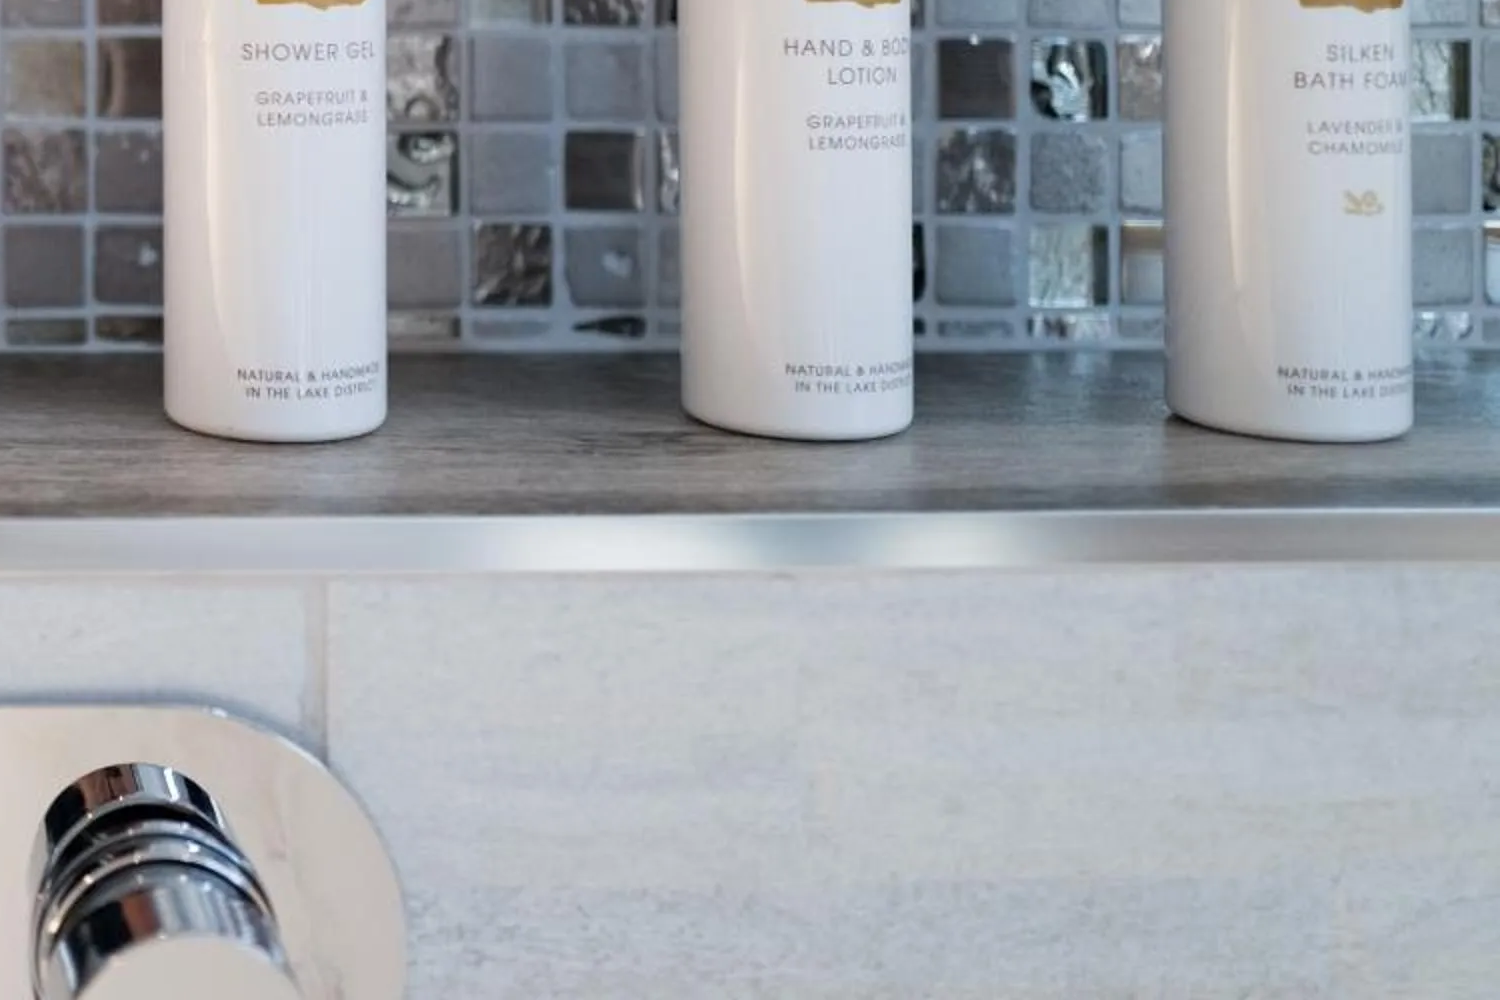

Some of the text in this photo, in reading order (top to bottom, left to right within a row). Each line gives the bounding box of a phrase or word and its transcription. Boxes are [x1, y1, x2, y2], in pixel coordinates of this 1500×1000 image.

[241, 40, 376, 62] SHOWER GEL
[783, 38, 853, 57] HAND
[862, 39, 875, 57] &
[1326, 43, 1395, 63] SILKEN
[827, 67, 897, 86] LOTION
[1294, 71, 1354, 89] BATH
[255, 89, 356, 106] GRAPEFRUIT
[237, 368, 301, 383] NATURAL
[307, 371, 317, 383] &
[785, 363, 852, 377] NATURAL
[1277, 366, 1348, 381] NATURAL
[245, 387, 260, 399] IN
[266, 387, 290, 400] THE
[297, 387, 329, 400] LAKE
[795, 381, 810, 393] IN
[816, 380, 841, 394] THE
[846, 381, 877, 394] LAKE
[1287, 382, 1305, 396] IN
[1309, 385, 1337, 399] THE
[1342, 386, 1375, 399] LAKE
